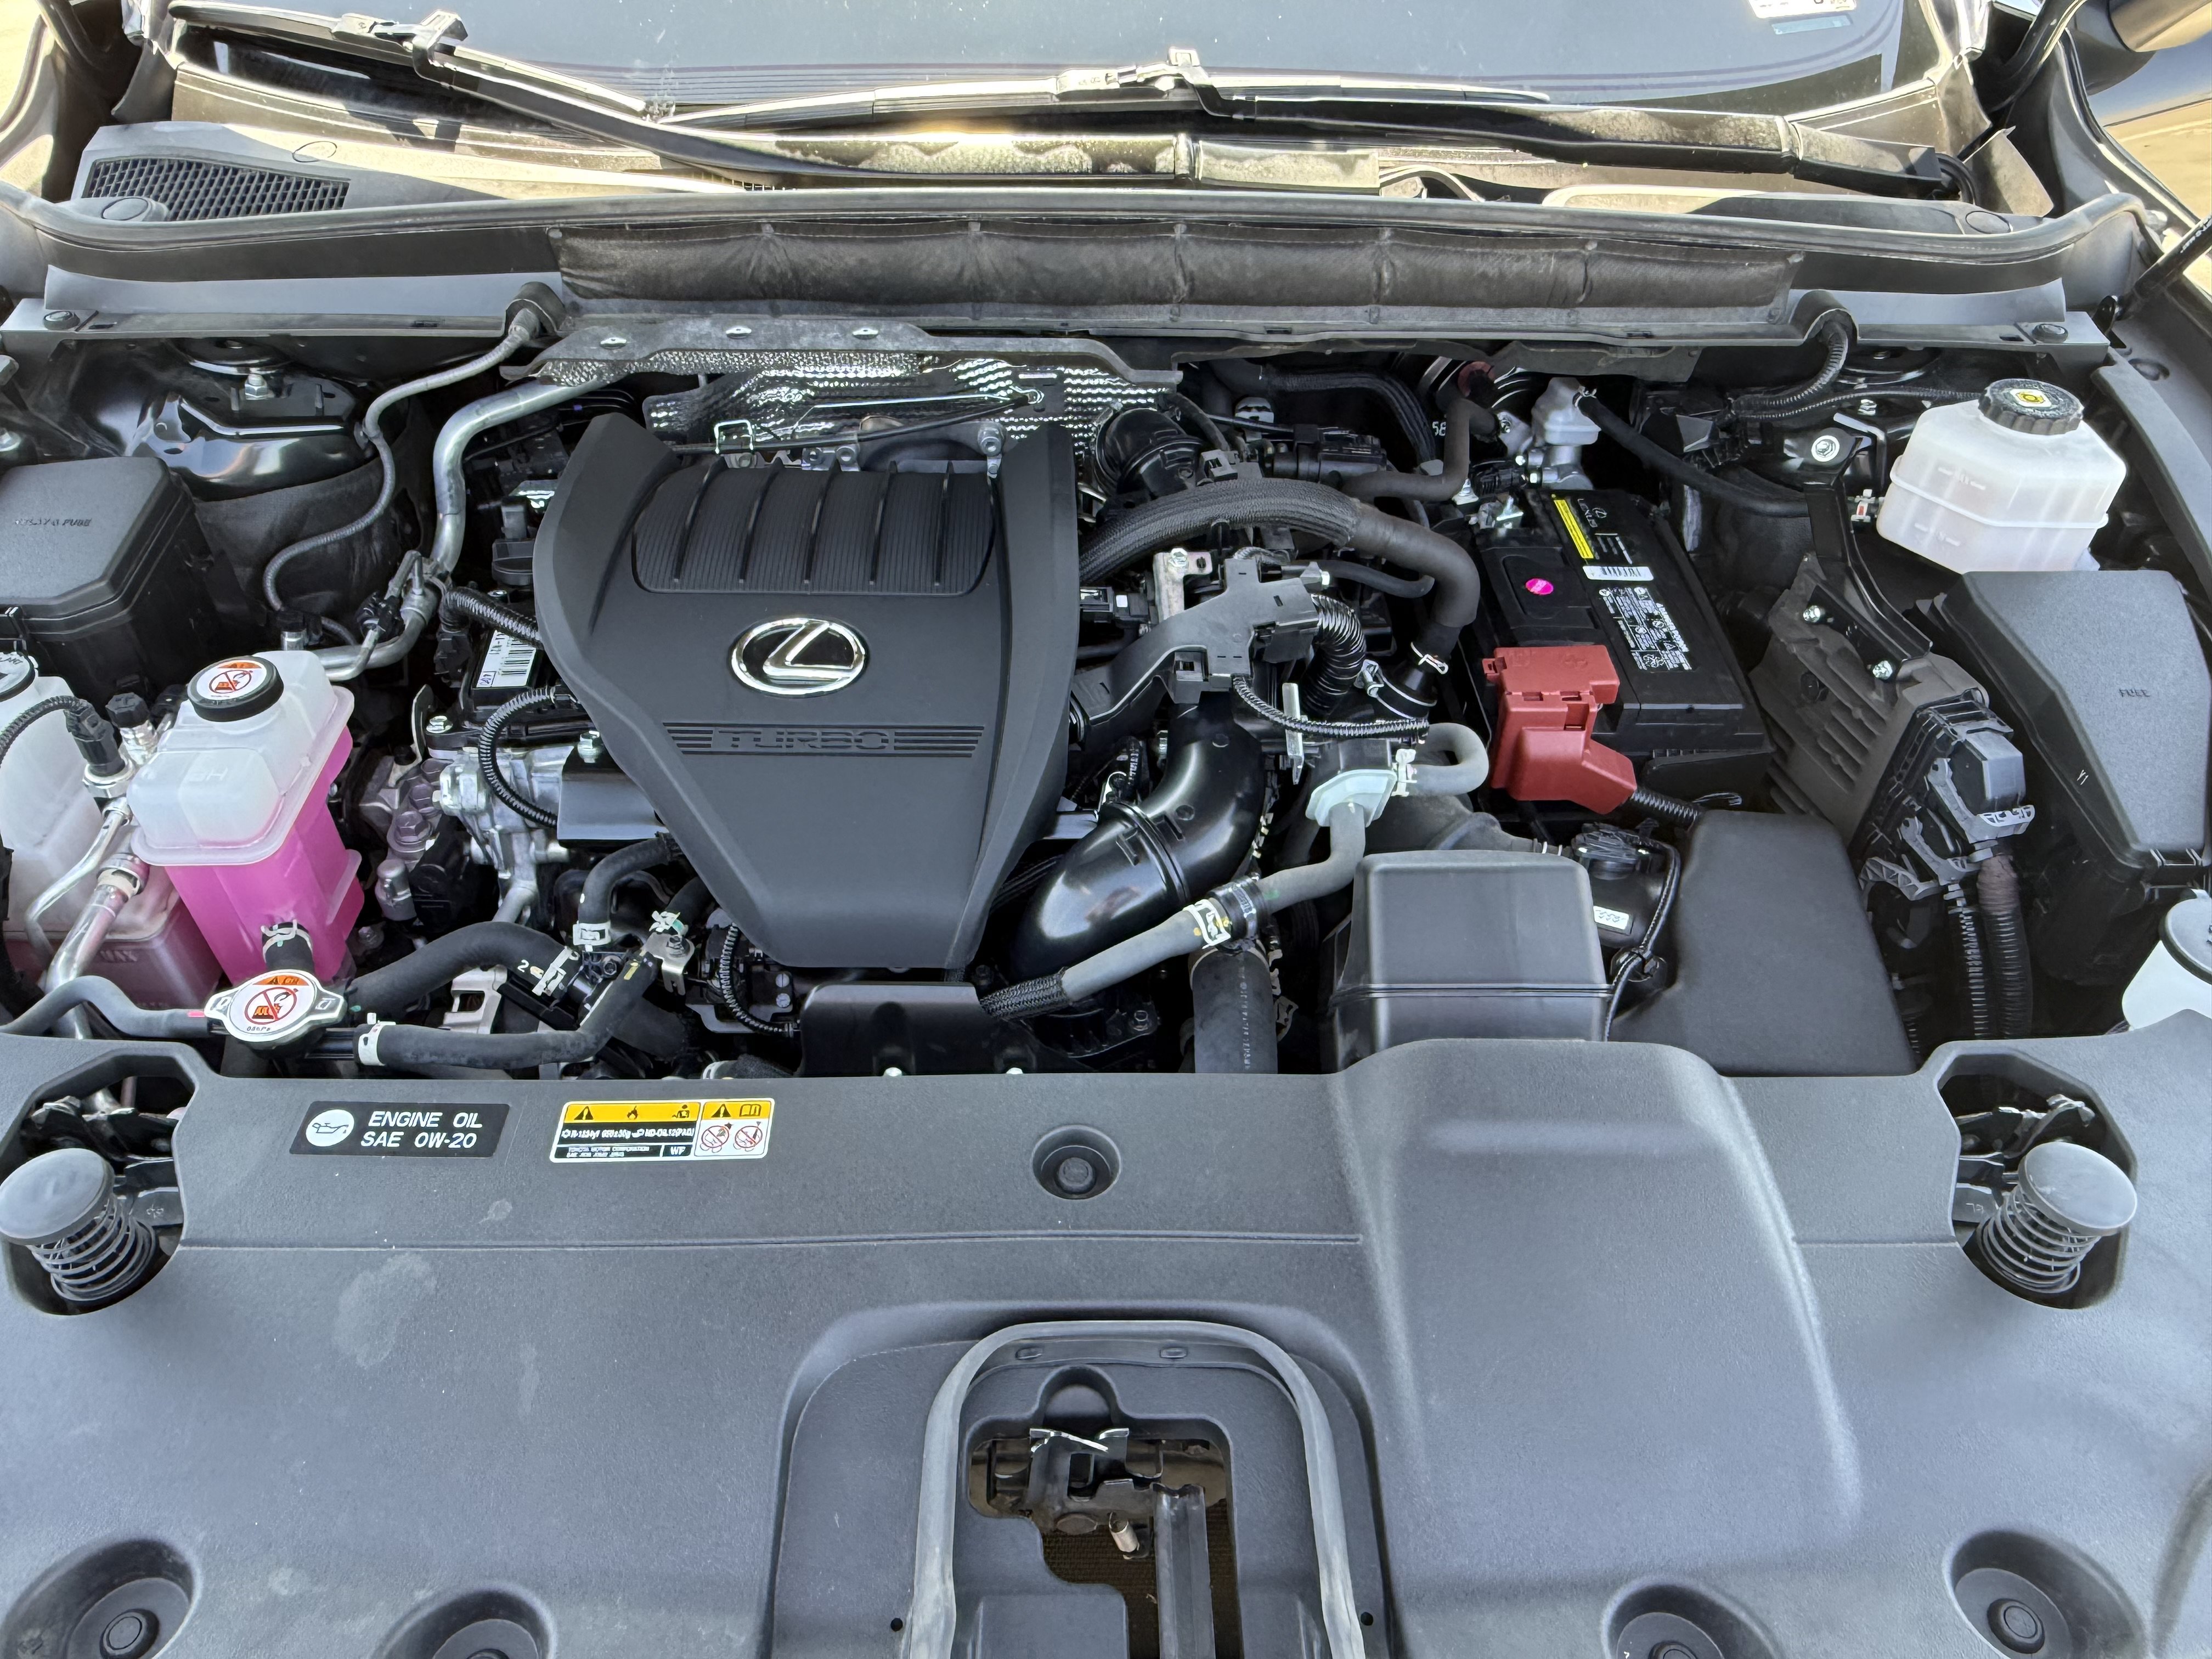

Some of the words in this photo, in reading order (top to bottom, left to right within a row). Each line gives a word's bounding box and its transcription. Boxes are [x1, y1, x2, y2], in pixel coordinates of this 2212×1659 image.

[718, 730, 889, 750] TURBO
[517, 959, 529, 973] 2
[368, 1111, 443, 1127] ENGINE
[453, 1112, 483, 1128] OIL
[360, 1131, 404, 1147] SAE
[414, 1132, 477, 1149] 0W-20
